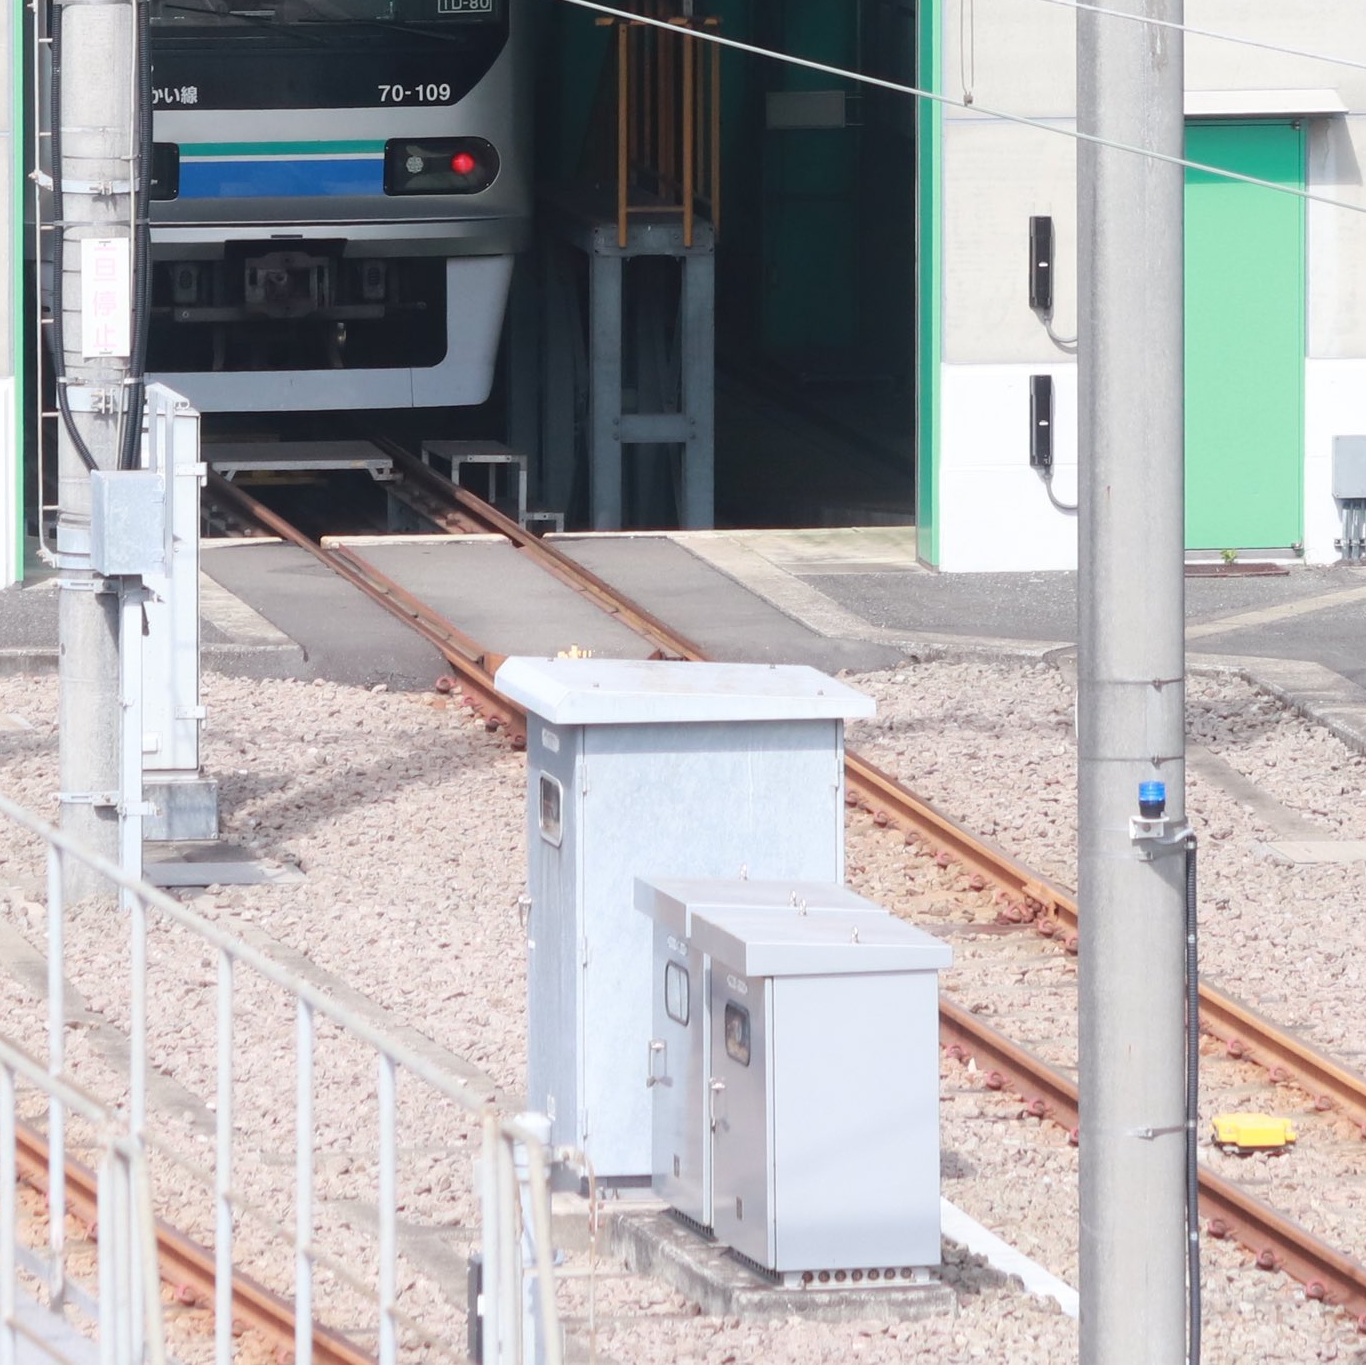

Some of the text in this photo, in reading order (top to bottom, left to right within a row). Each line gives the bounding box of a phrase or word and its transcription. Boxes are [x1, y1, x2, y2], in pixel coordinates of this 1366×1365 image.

[378, 83, 451, 102] 70-109
[93, 246, 118, 348] 一旦停止
